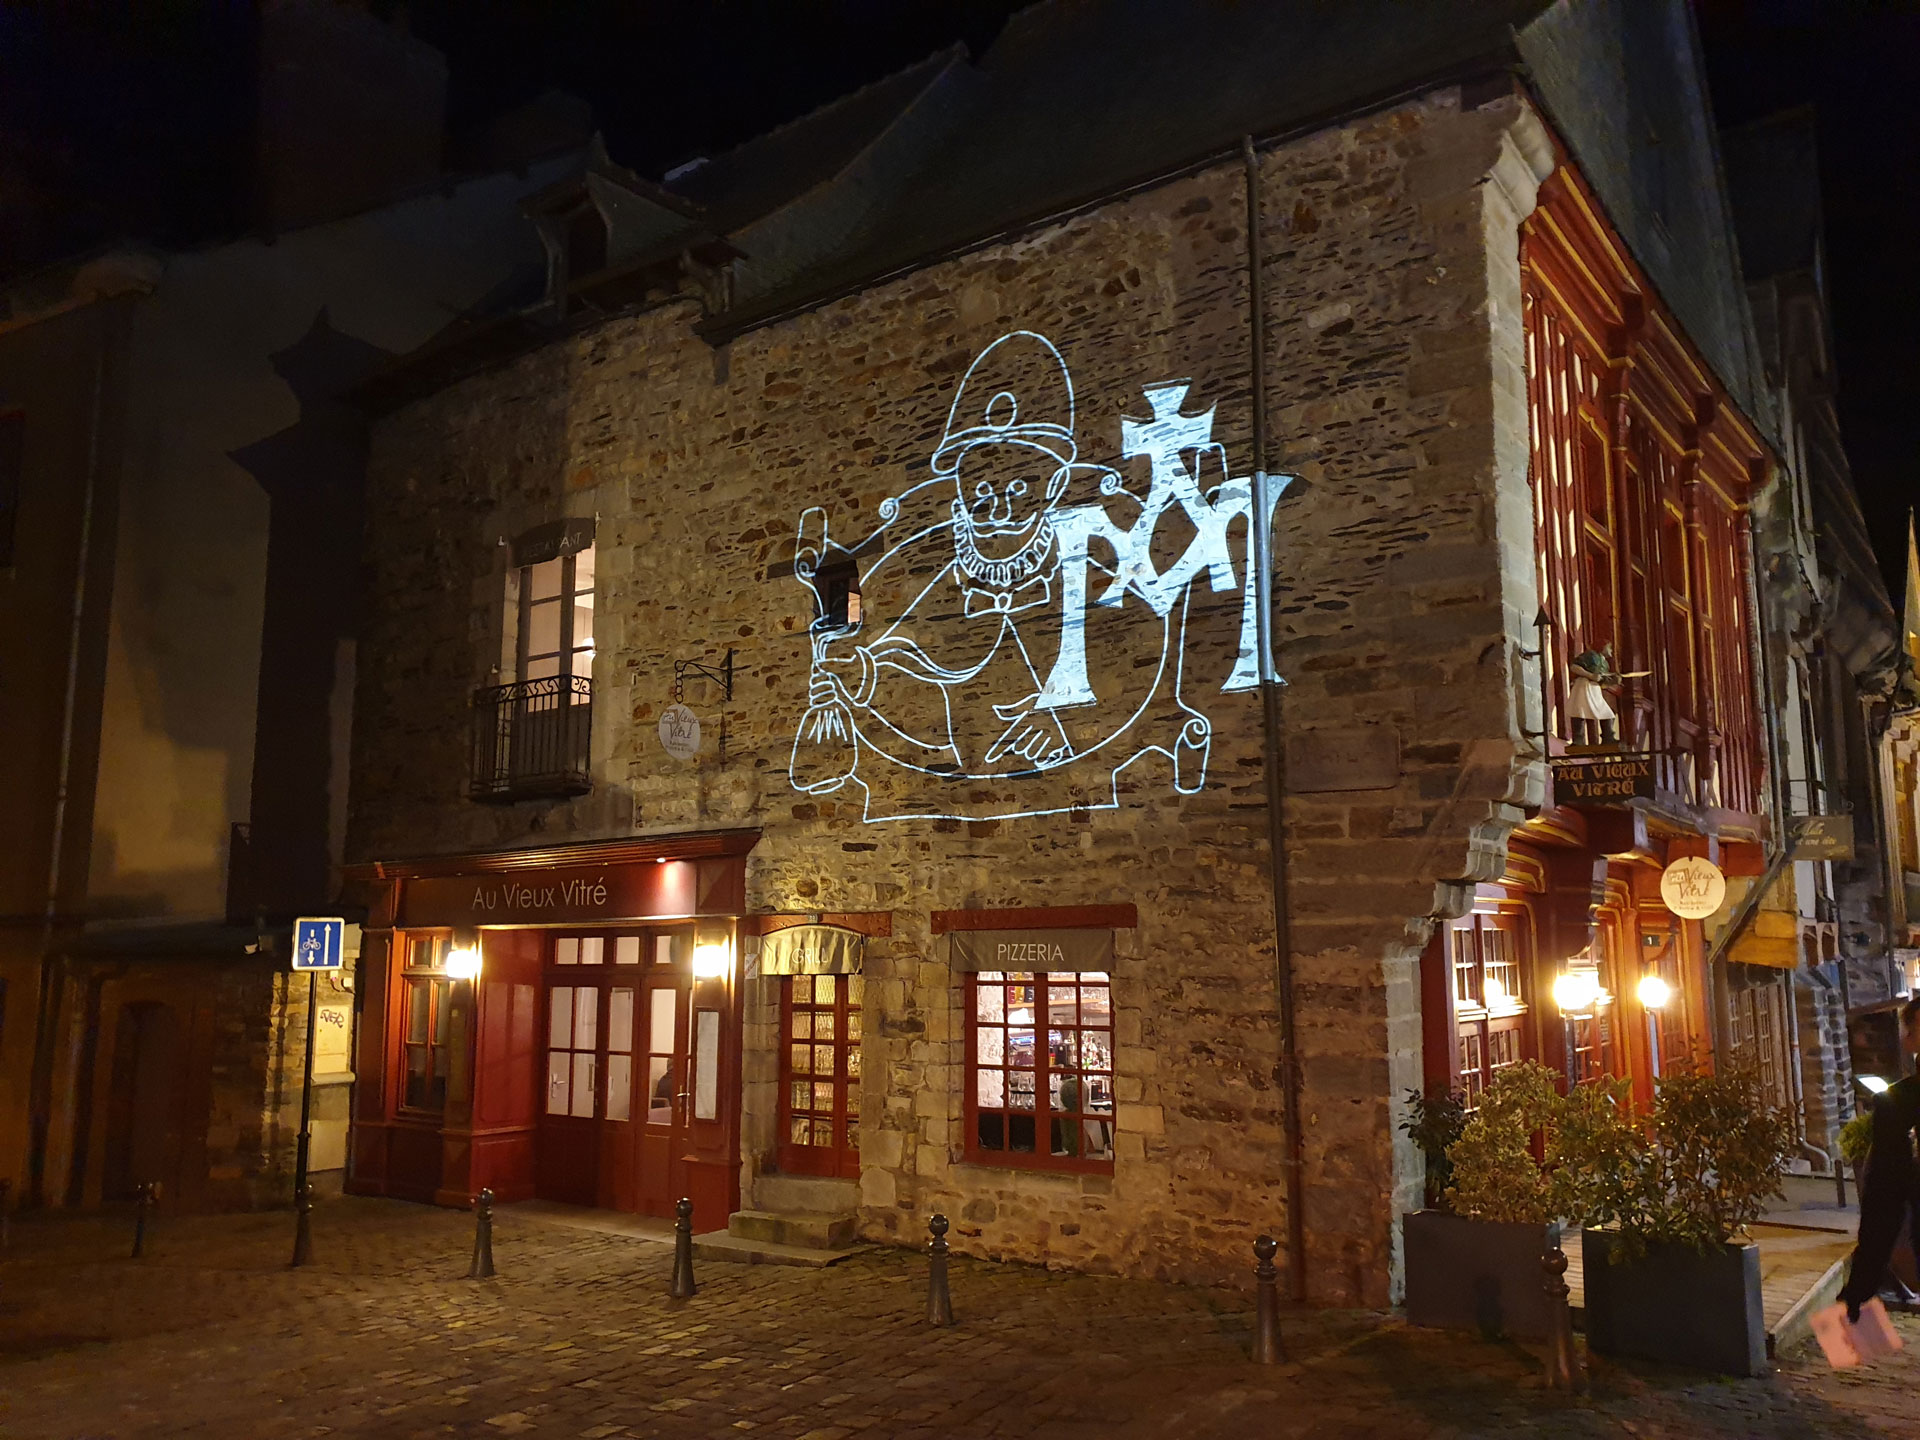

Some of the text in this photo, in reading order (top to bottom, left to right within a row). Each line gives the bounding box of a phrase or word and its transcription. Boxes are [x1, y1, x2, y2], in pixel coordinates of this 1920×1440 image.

[1558, 762, 1649, 780] AU VIEUX
[1572, 778, 1636, 797] VITRÉ
[1684, 866, 1716, 884] Vieux
[472, 876, 607, 910] Au Vieux Vitré
[791, 947, 829, 964] GRILL
[997, 943, 1065, 961] PIZZERIA
